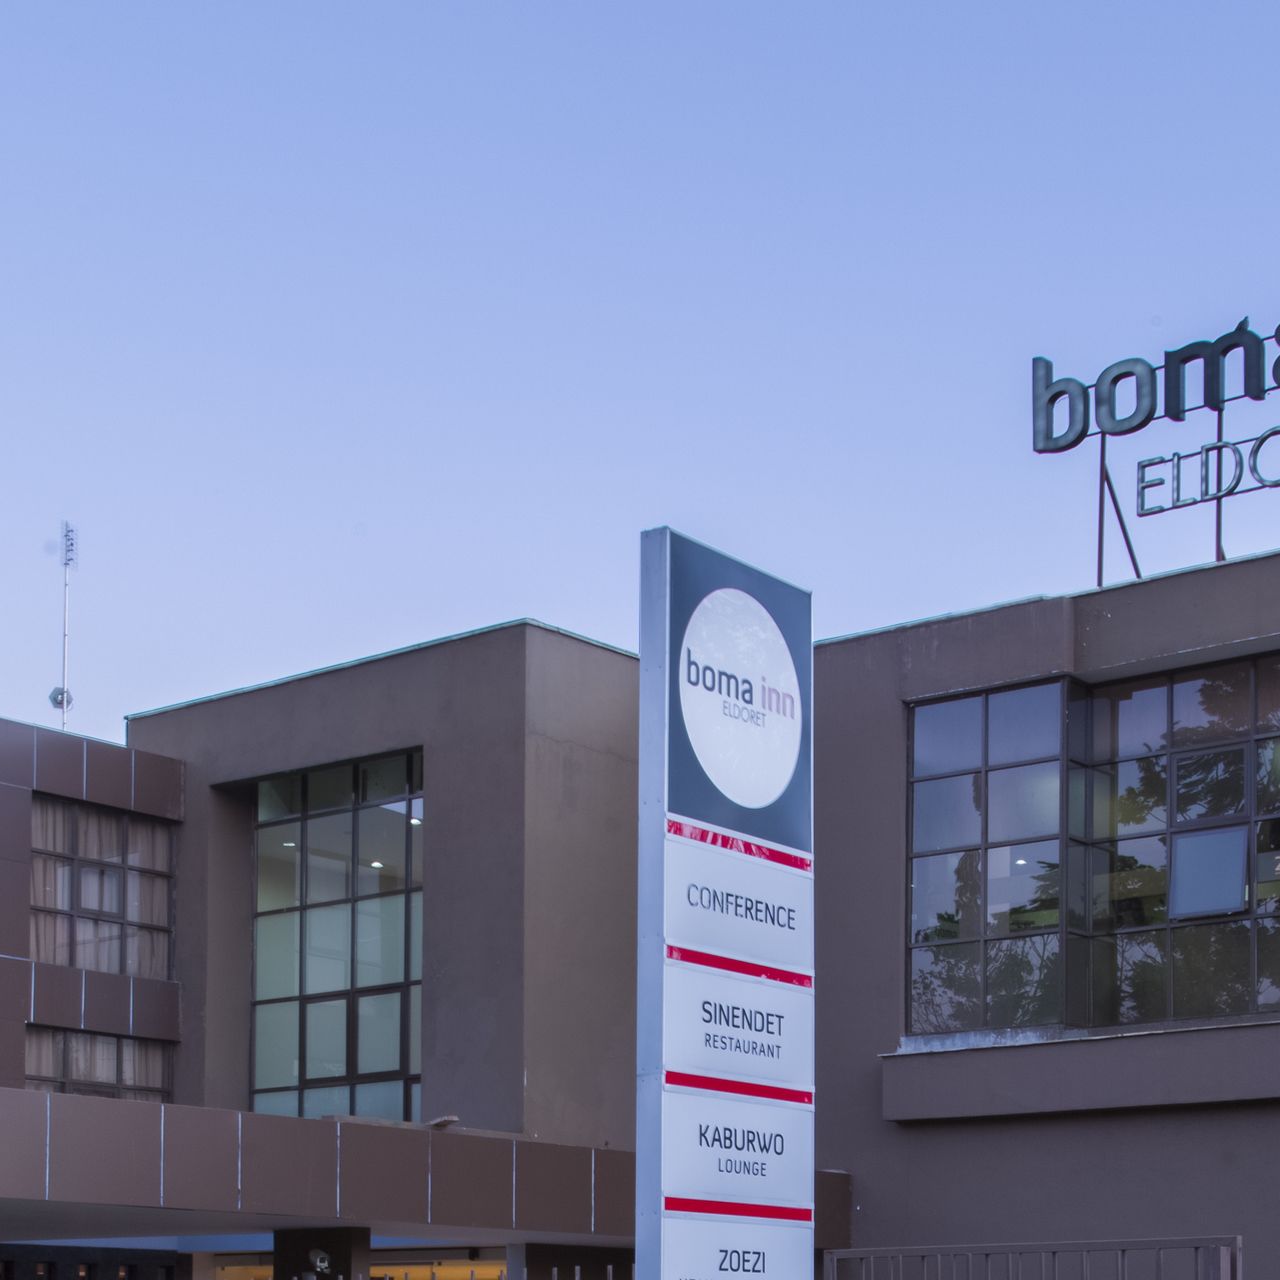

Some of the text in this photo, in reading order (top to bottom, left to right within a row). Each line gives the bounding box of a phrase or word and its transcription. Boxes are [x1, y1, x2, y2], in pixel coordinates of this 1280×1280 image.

[686, 647, 795, 720] boma inn
[722, 700, 767, 728] ELDORET
[686, 883, 797, 931] CONFERENCE
[702, 1000, 785, 1036] SINENDET
[704, 1033, 782, 1060] RESTAURANT
[699, 1123, 785, 1156] KABURWO
[718, 1158, 767, 1177] LOUNGE
[719, 1249, 766, 1273] ZOEZI
